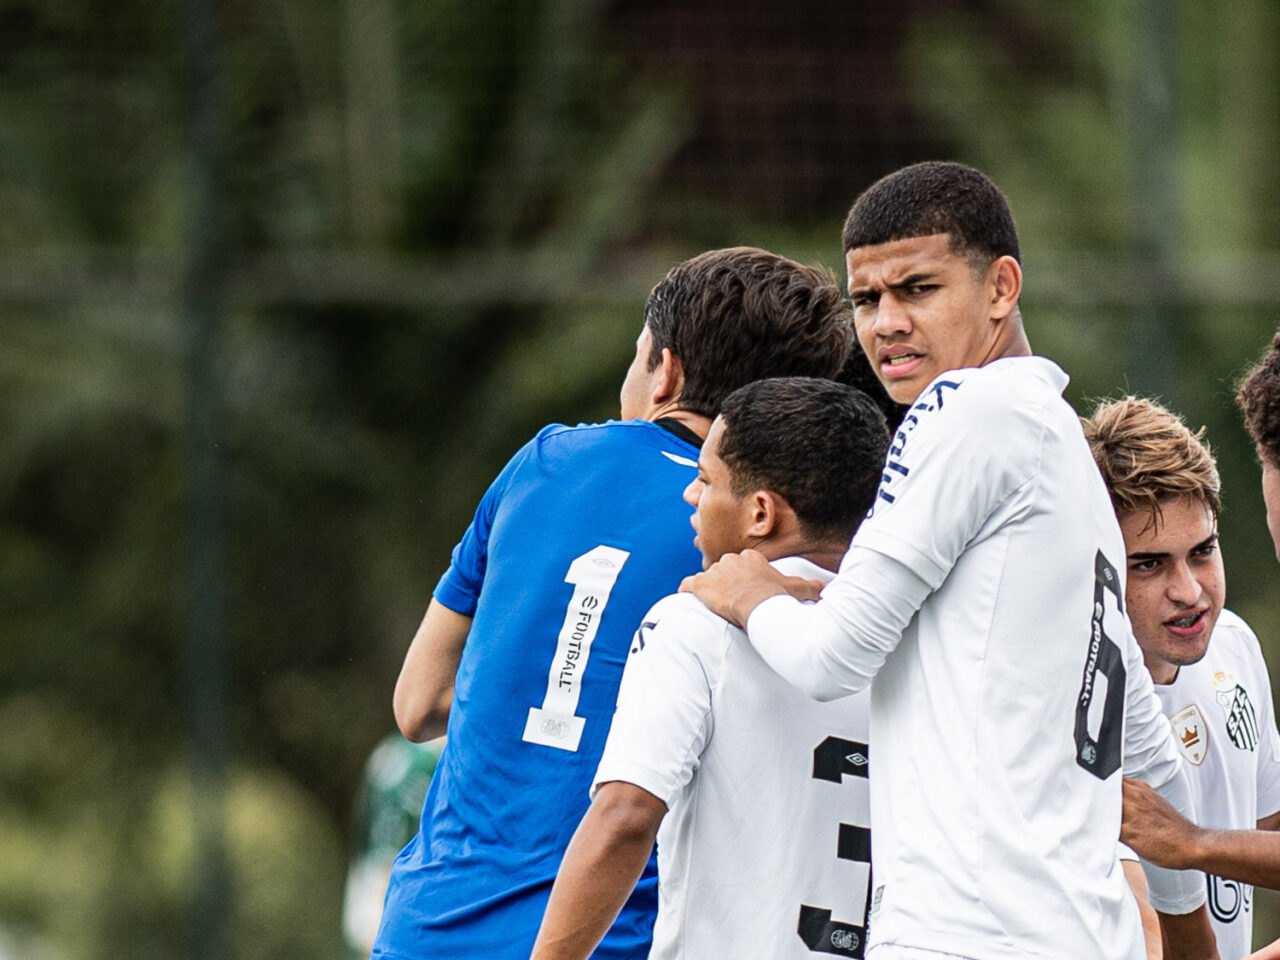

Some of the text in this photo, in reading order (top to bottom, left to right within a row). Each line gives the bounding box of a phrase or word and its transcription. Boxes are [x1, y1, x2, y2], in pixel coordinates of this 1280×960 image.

[522, 544, 631, 752] 1
[1074, 548, 1127, 780] 6
[797, 734, 873, 960] 3
